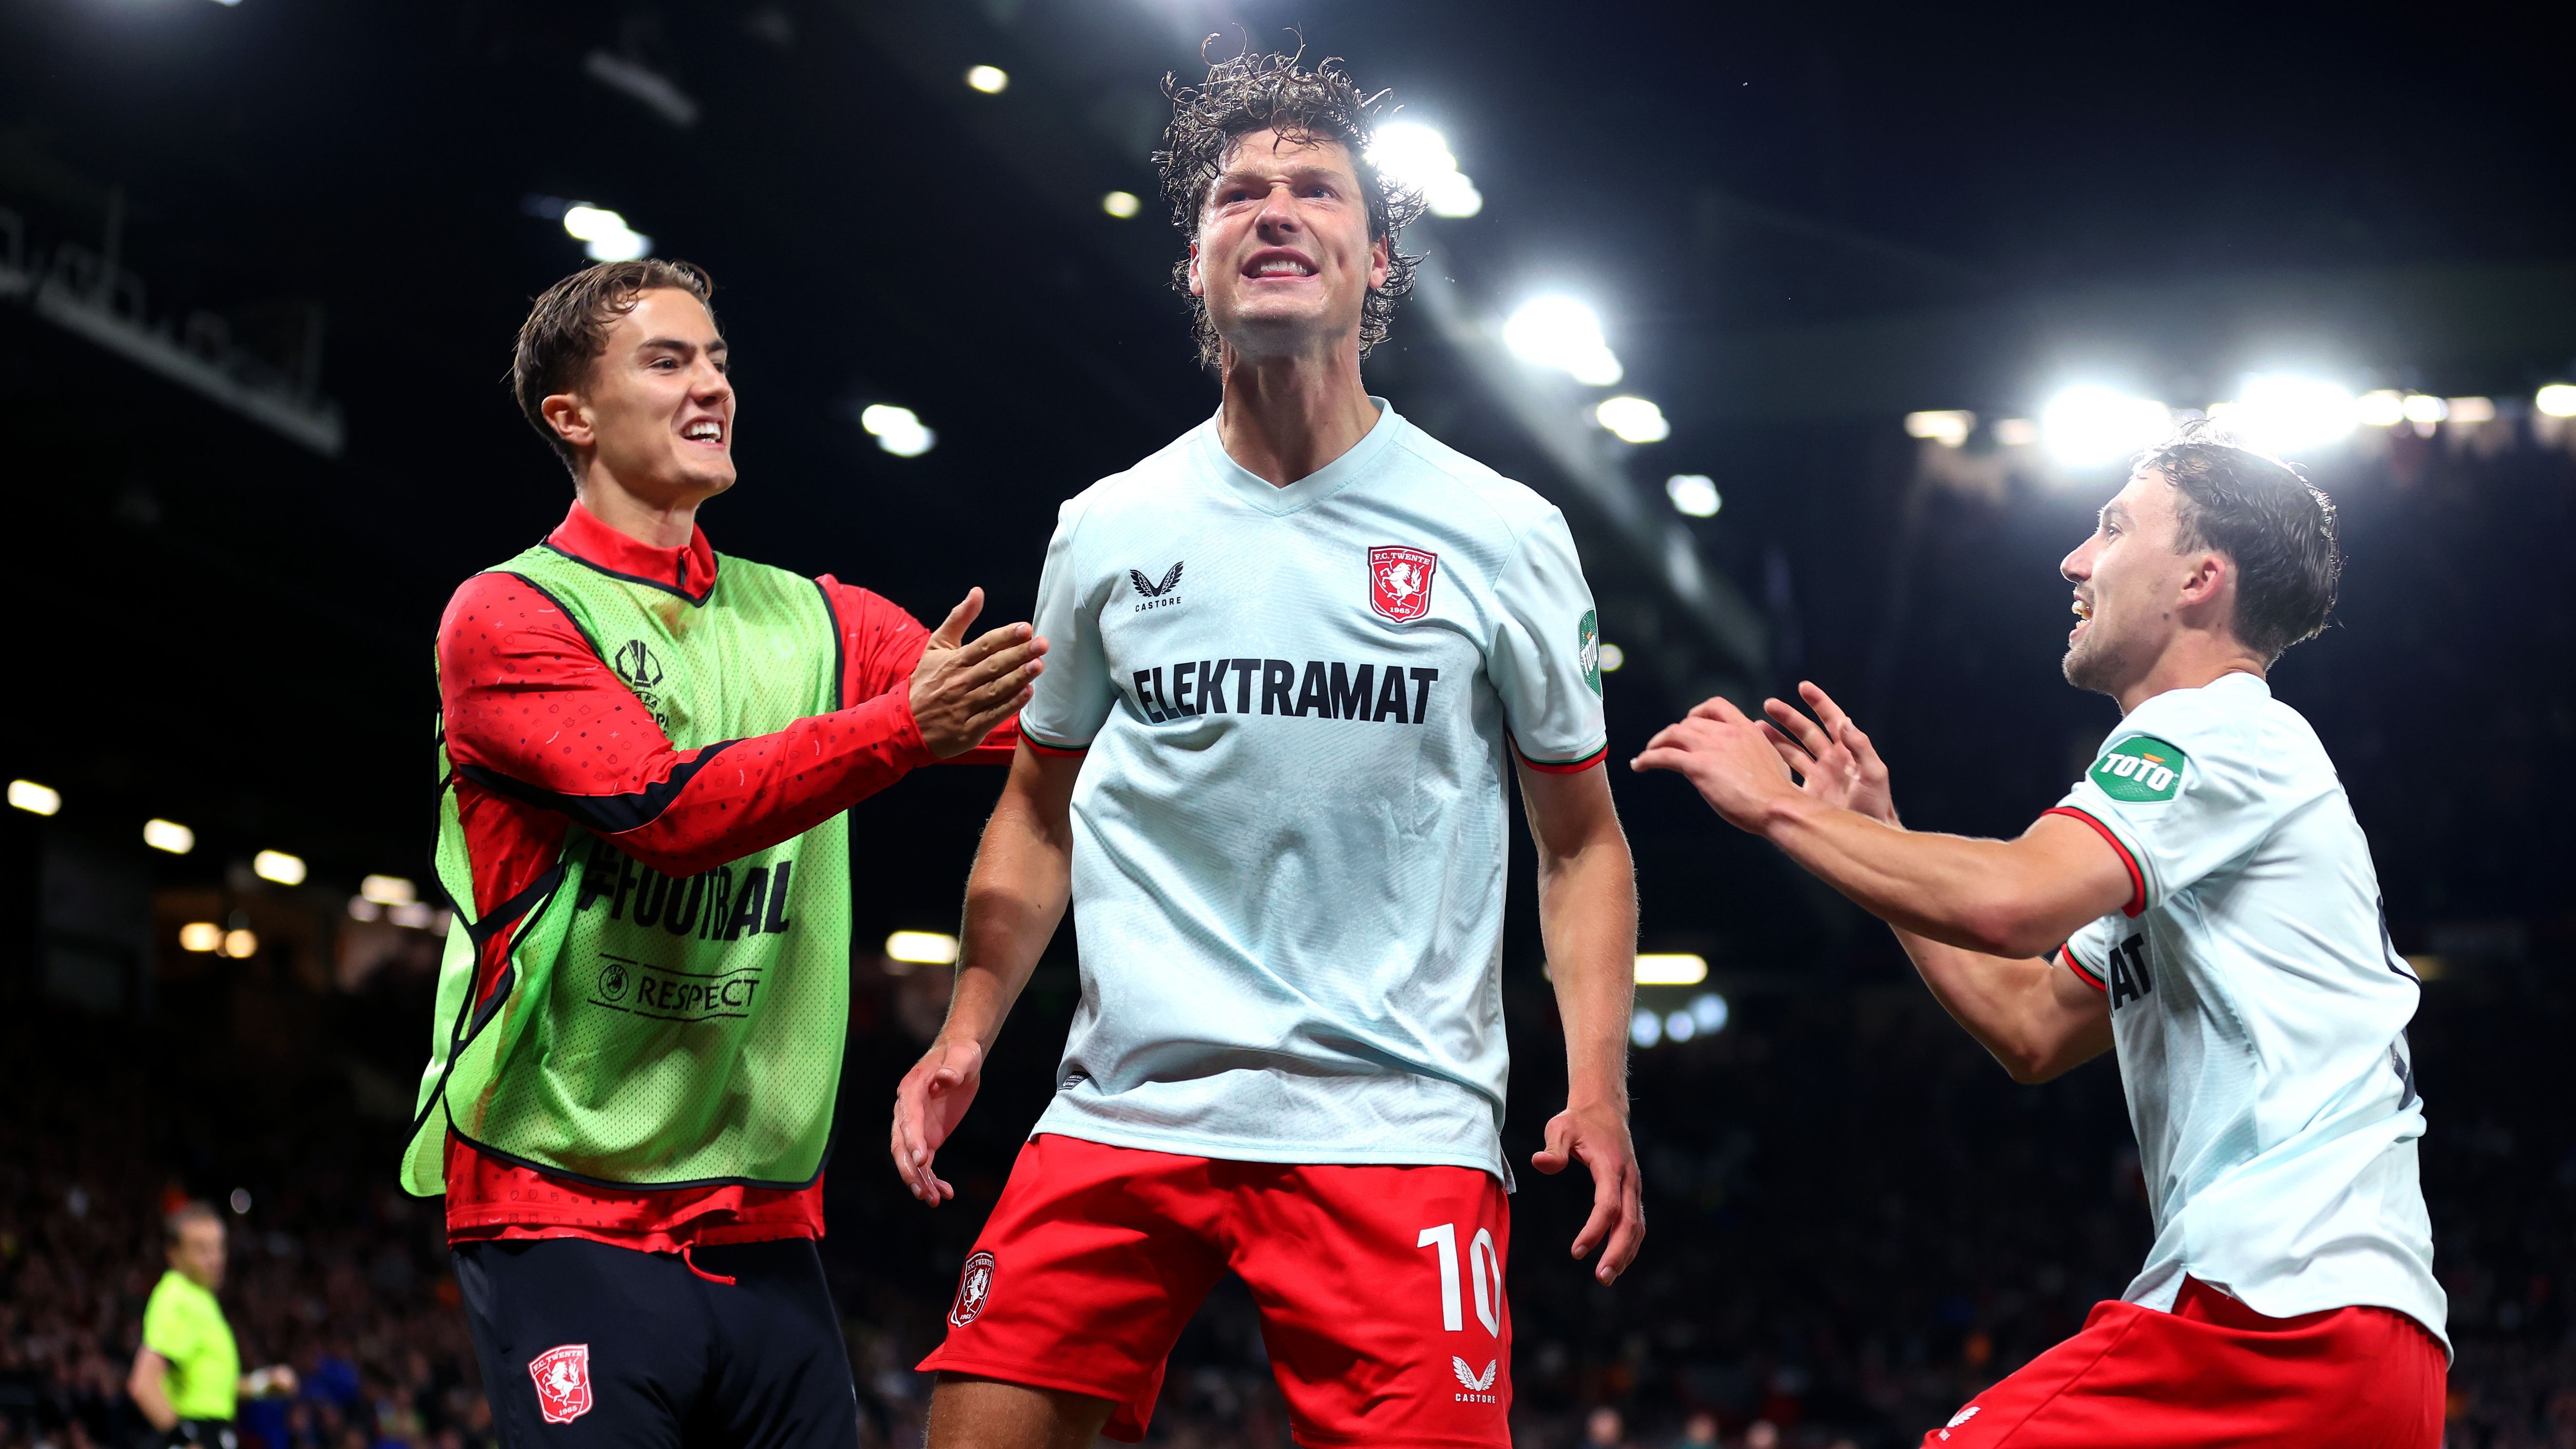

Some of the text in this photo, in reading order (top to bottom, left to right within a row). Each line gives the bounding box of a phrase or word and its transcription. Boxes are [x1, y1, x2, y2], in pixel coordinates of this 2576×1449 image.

[1374, 552, 1431, 565] F.C. TWENTE
[1135, 596, 1181, 612] CASTORE
[1133, 658, 1439, 725] ELEKTRAMAT
[2100, 752, 2174, 791] TOTO
[2108, 932, 2152, 1010] AT
[637, 976, 760, 1011] RESPECT
[975, 1258, 992, 1267] TWENTE
[1417, 1222, 1501, 1339] 10
[546, 1350, 584, 1363] TWENTE
[1455, 1392, 1496, 1404] CASTORE
[558, 1405, 578, 1417] 1965
